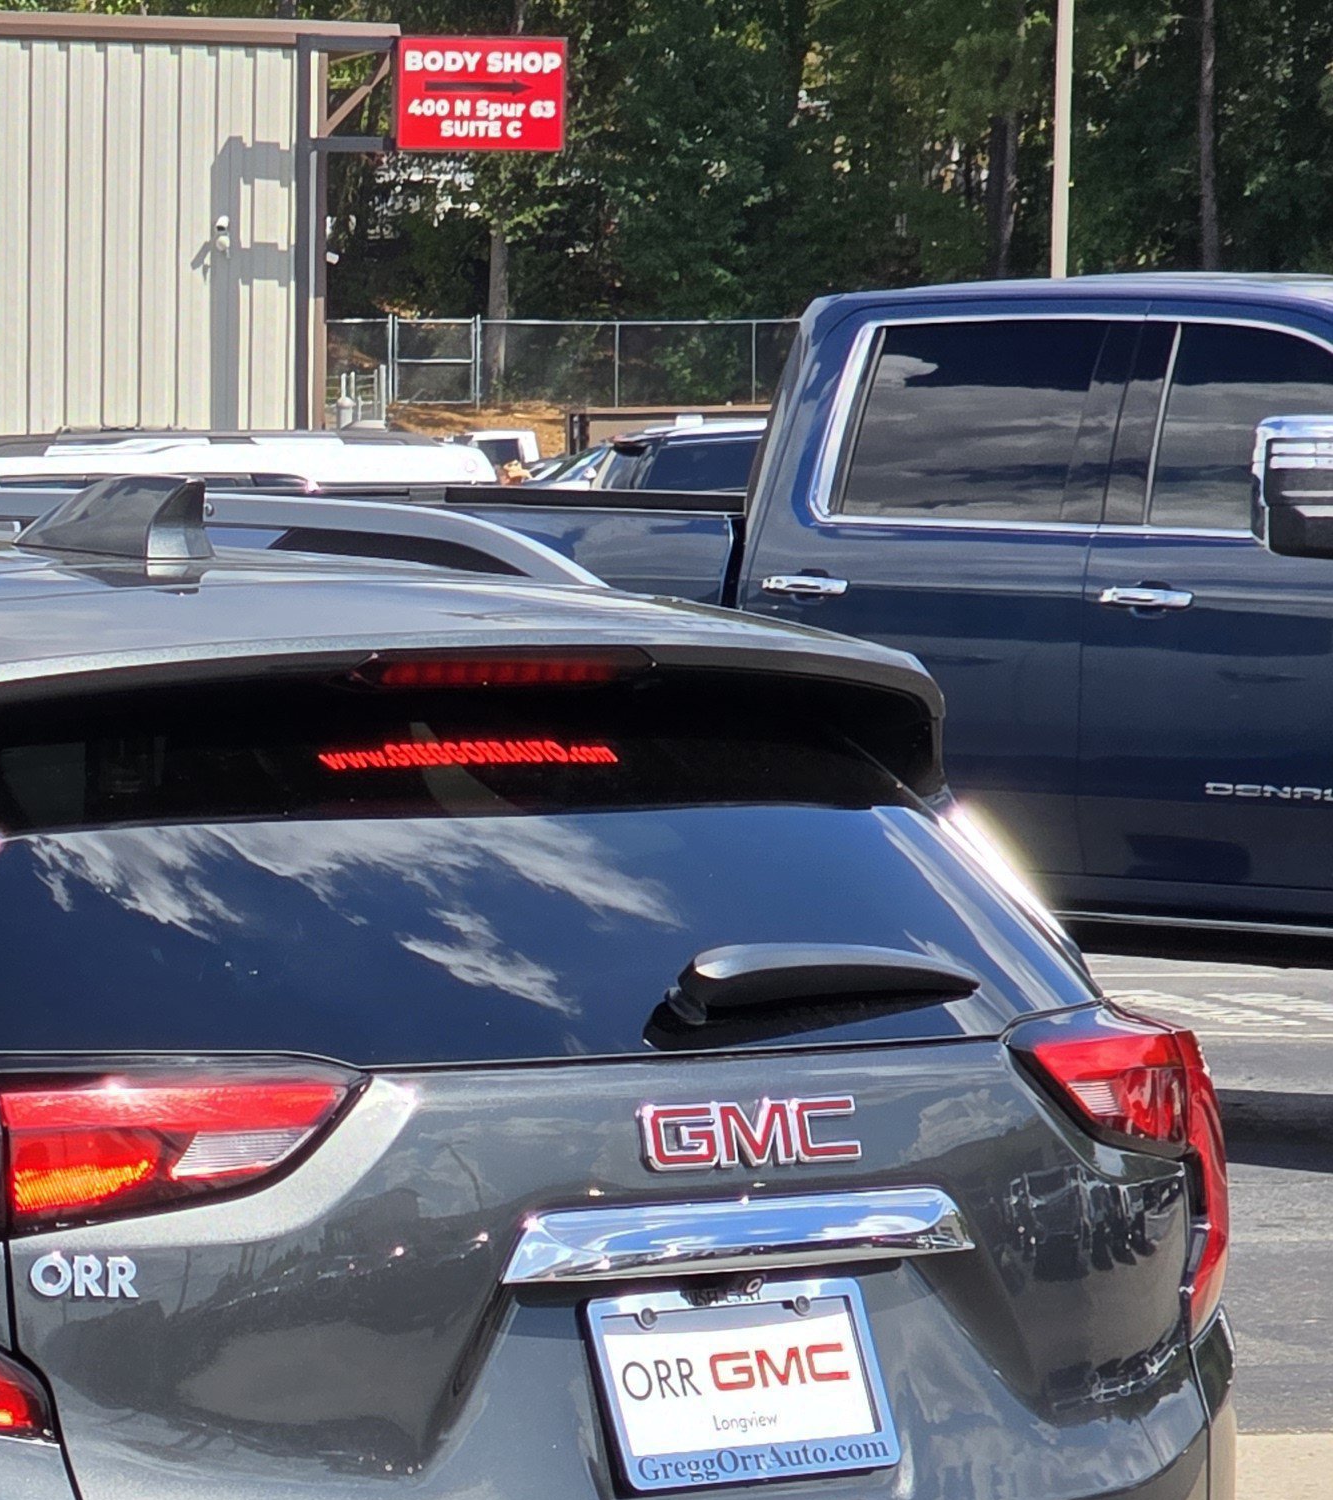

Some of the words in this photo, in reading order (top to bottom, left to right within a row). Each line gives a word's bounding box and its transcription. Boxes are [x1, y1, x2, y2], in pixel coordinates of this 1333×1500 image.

[404, 50, 482, 73] BODY
[486, 51, 562, 74] SHOP
[408, 98, 450, 117] 400
[454, 100, 471, 117] N
[475, 100, 526, 121] Spur
[529, 100, 556, 119] 63
[440, 119, 502, 138] SUITE
[506, 121, 522, 138] C
[318, 739, 618, 770] www.GREGGORRAUTO.com
[636, 1095, 862, 1172] GMC
[29, 1250, 140, 1299] ORR
[622, 1358, 702, 1401] ORR
[709, 1343, 850, 1392] GMC
[712, 1411, 778, 1433] Longview
[637, 1439, 890, 1482] GreggOrrAuto.com
